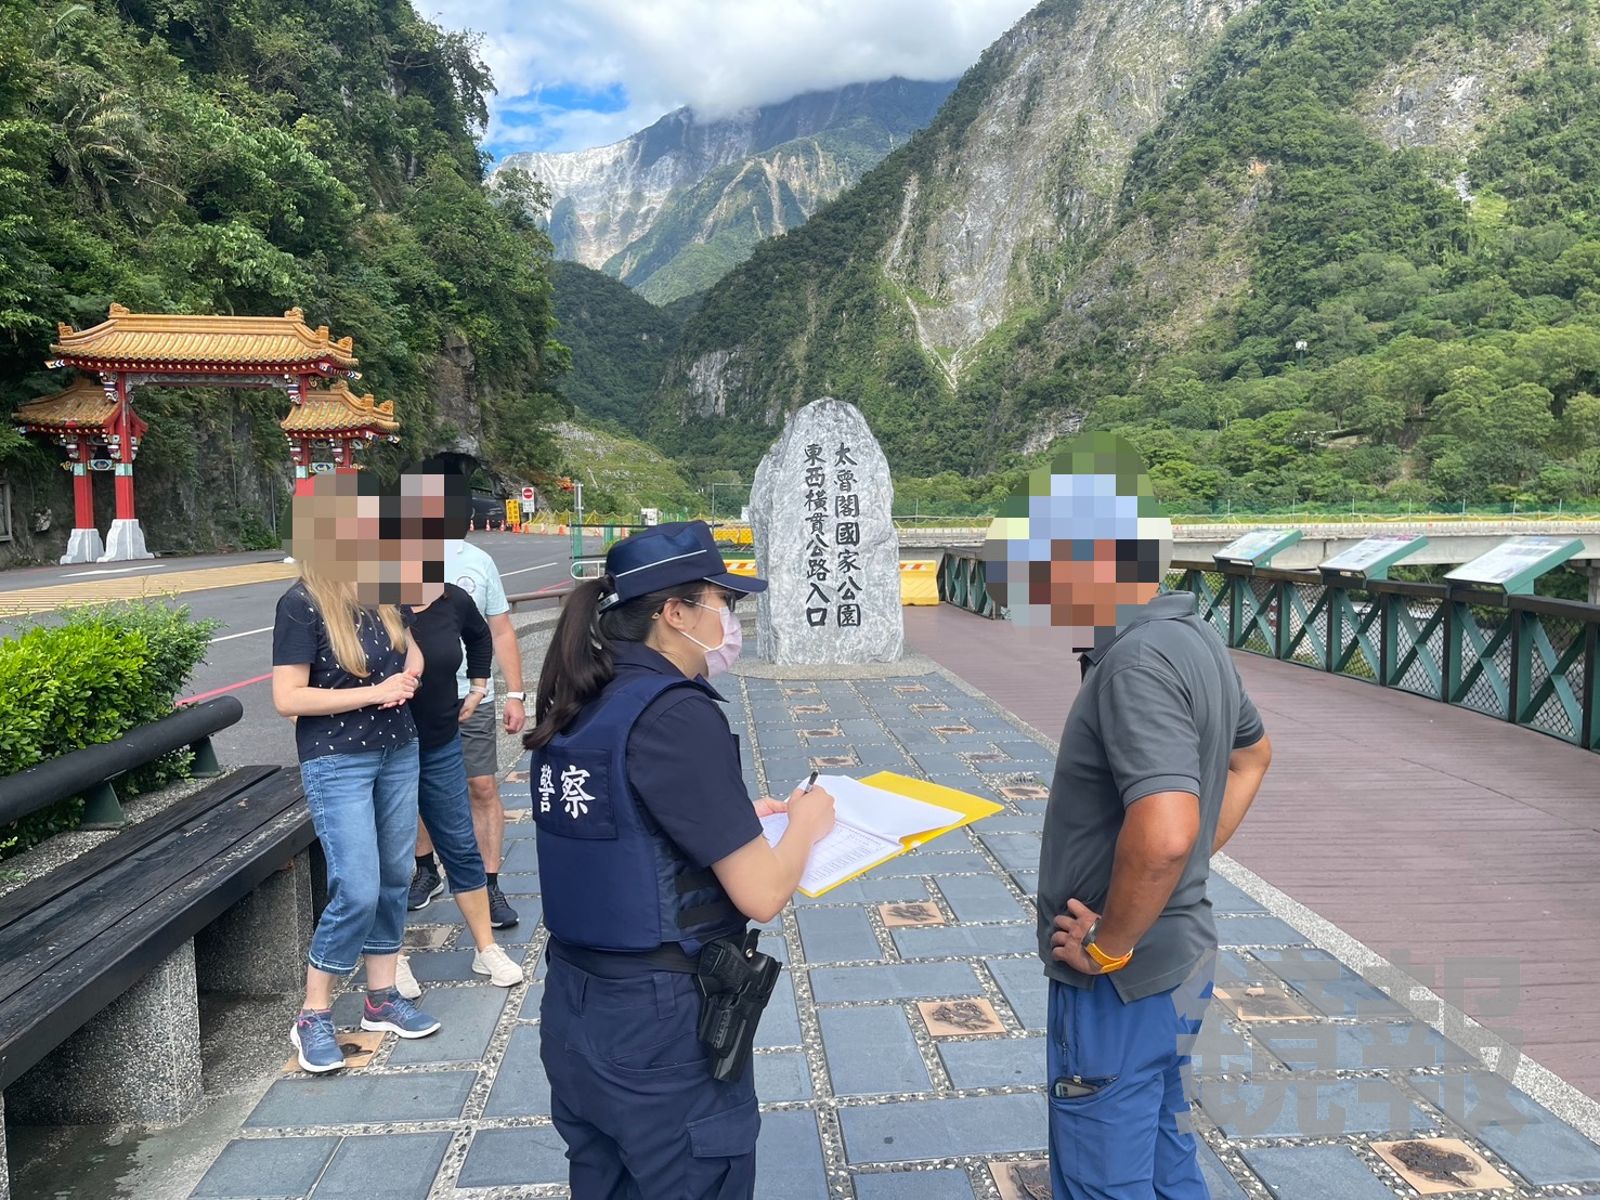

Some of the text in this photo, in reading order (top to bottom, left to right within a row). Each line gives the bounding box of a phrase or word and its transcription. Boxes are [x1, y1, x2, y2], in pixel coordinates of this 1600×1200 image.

[803, 443, 831, 627] 東西橫貫公路入口
[833, 442, 863, 628] 太魯閣國家公園
[537, 763, 596, 819] 警察
